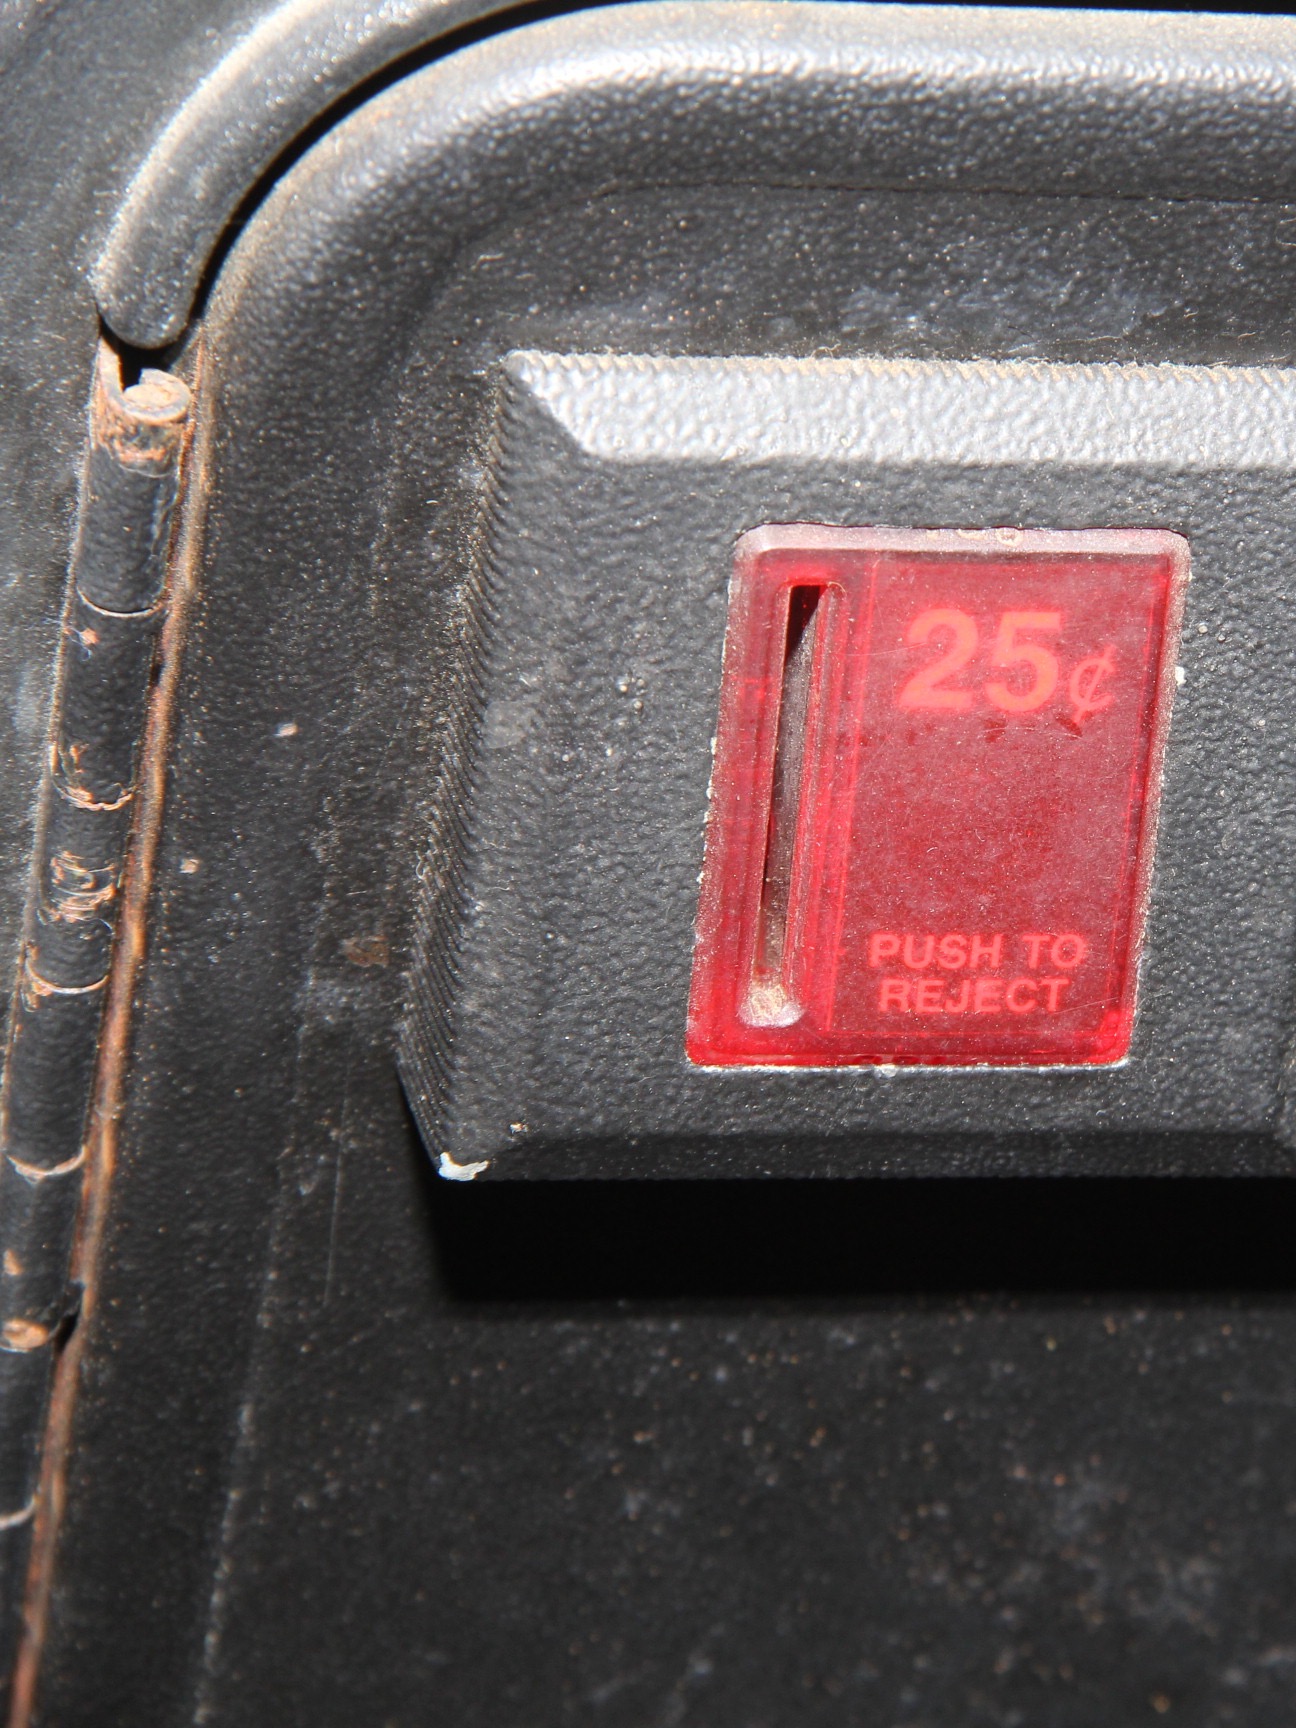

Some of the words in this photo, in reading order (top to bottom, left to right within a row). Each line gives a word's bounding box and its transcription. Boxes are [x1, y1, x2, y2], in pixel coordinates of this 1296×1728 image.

[898, 607, 1118, 724] 25¢
[870, 933, 1003, 969] PUSH
[1022, 933, 1087, 969] TO
[879, 979, 1069, 1013] REJECT
